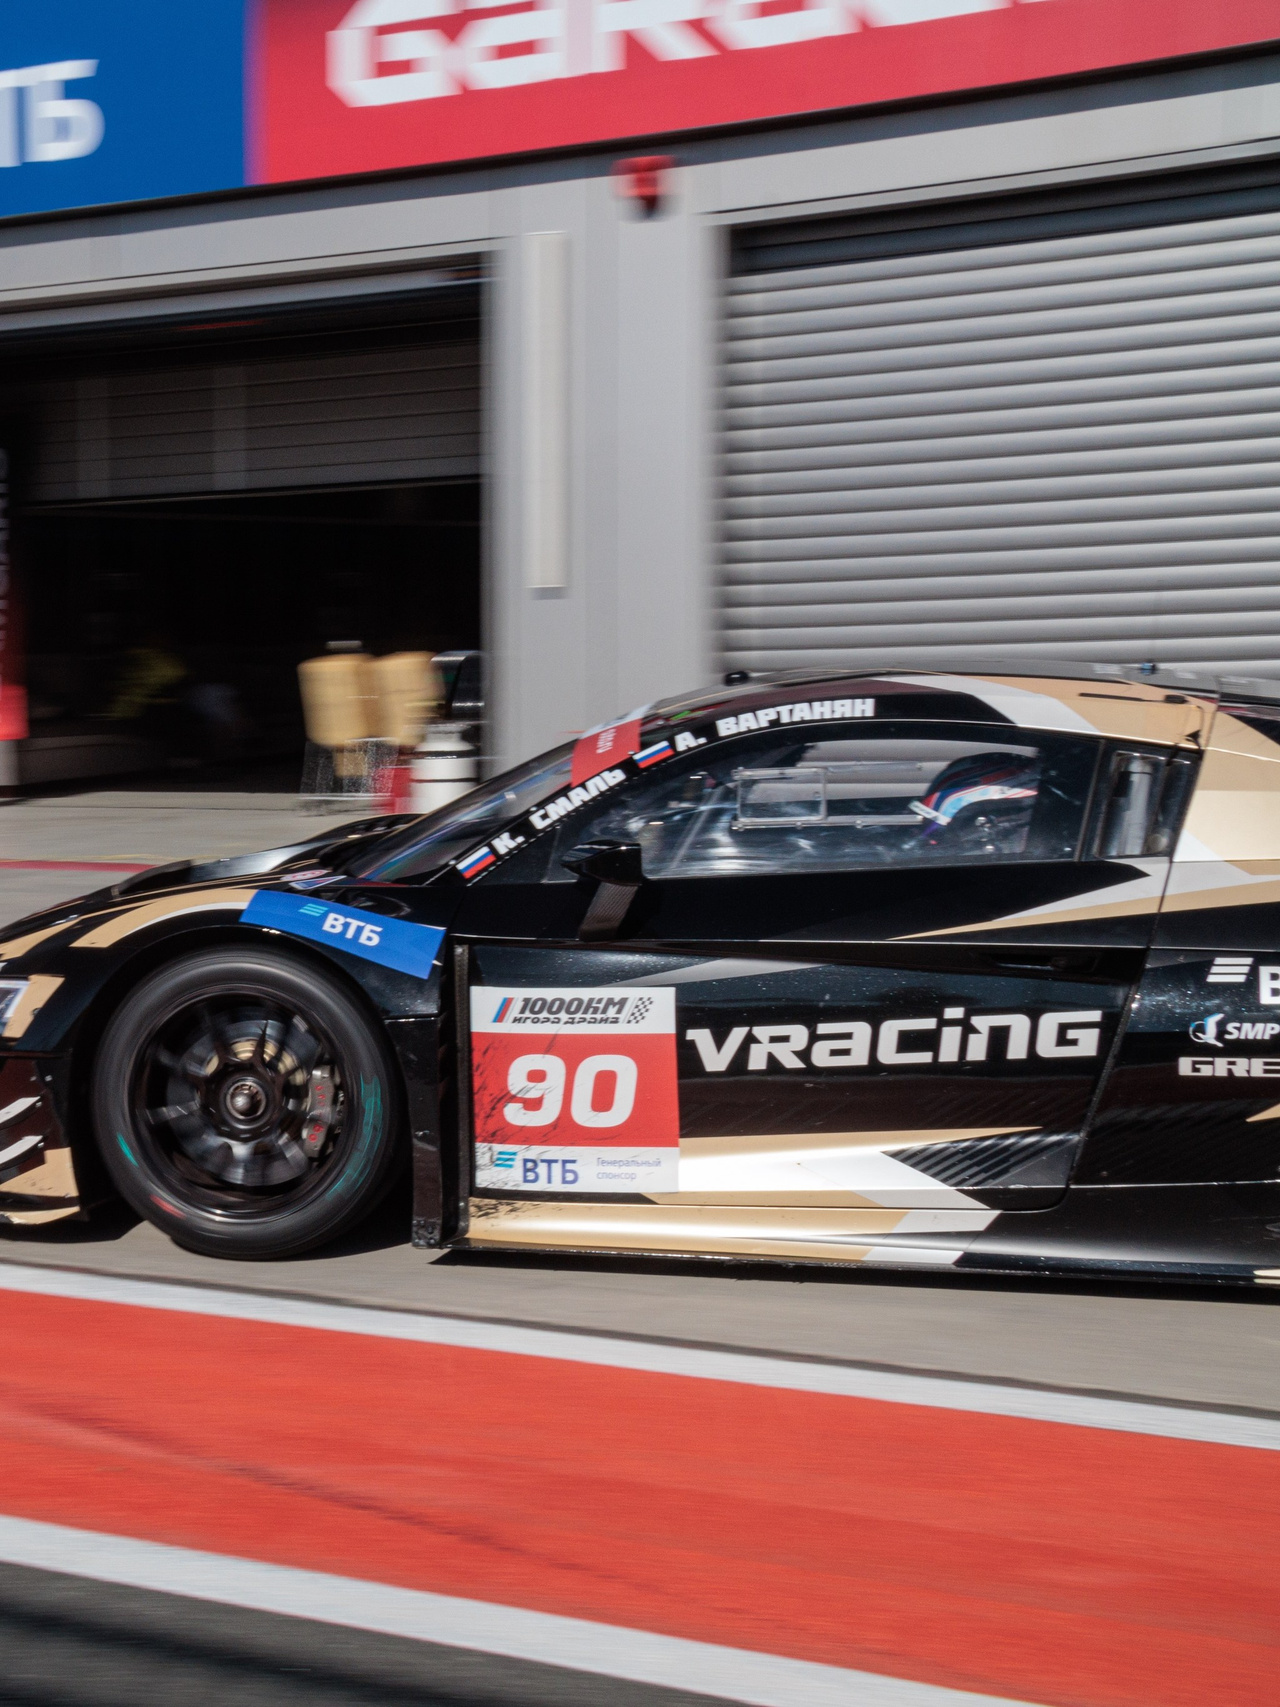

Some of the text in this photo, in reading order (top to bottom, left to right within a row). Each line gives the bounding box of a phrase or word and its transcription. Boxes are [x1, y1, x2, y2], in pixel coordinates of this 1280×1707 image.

[674, 698, 876, 752] А. ВАРТАНЯН
[491, 768, 627, 855] К. СМАЛЬ
[322, 912, 384, 947] ВТБ
[1224, 1022, 1280, 1040] SMP
[1178, 1056, 1280, 1078] GRE
[503, 1053, 638, 1128] 90
[523, 1157, 579, 1185] ВТБ
[596, 1172, 637, 1181] спонсор
